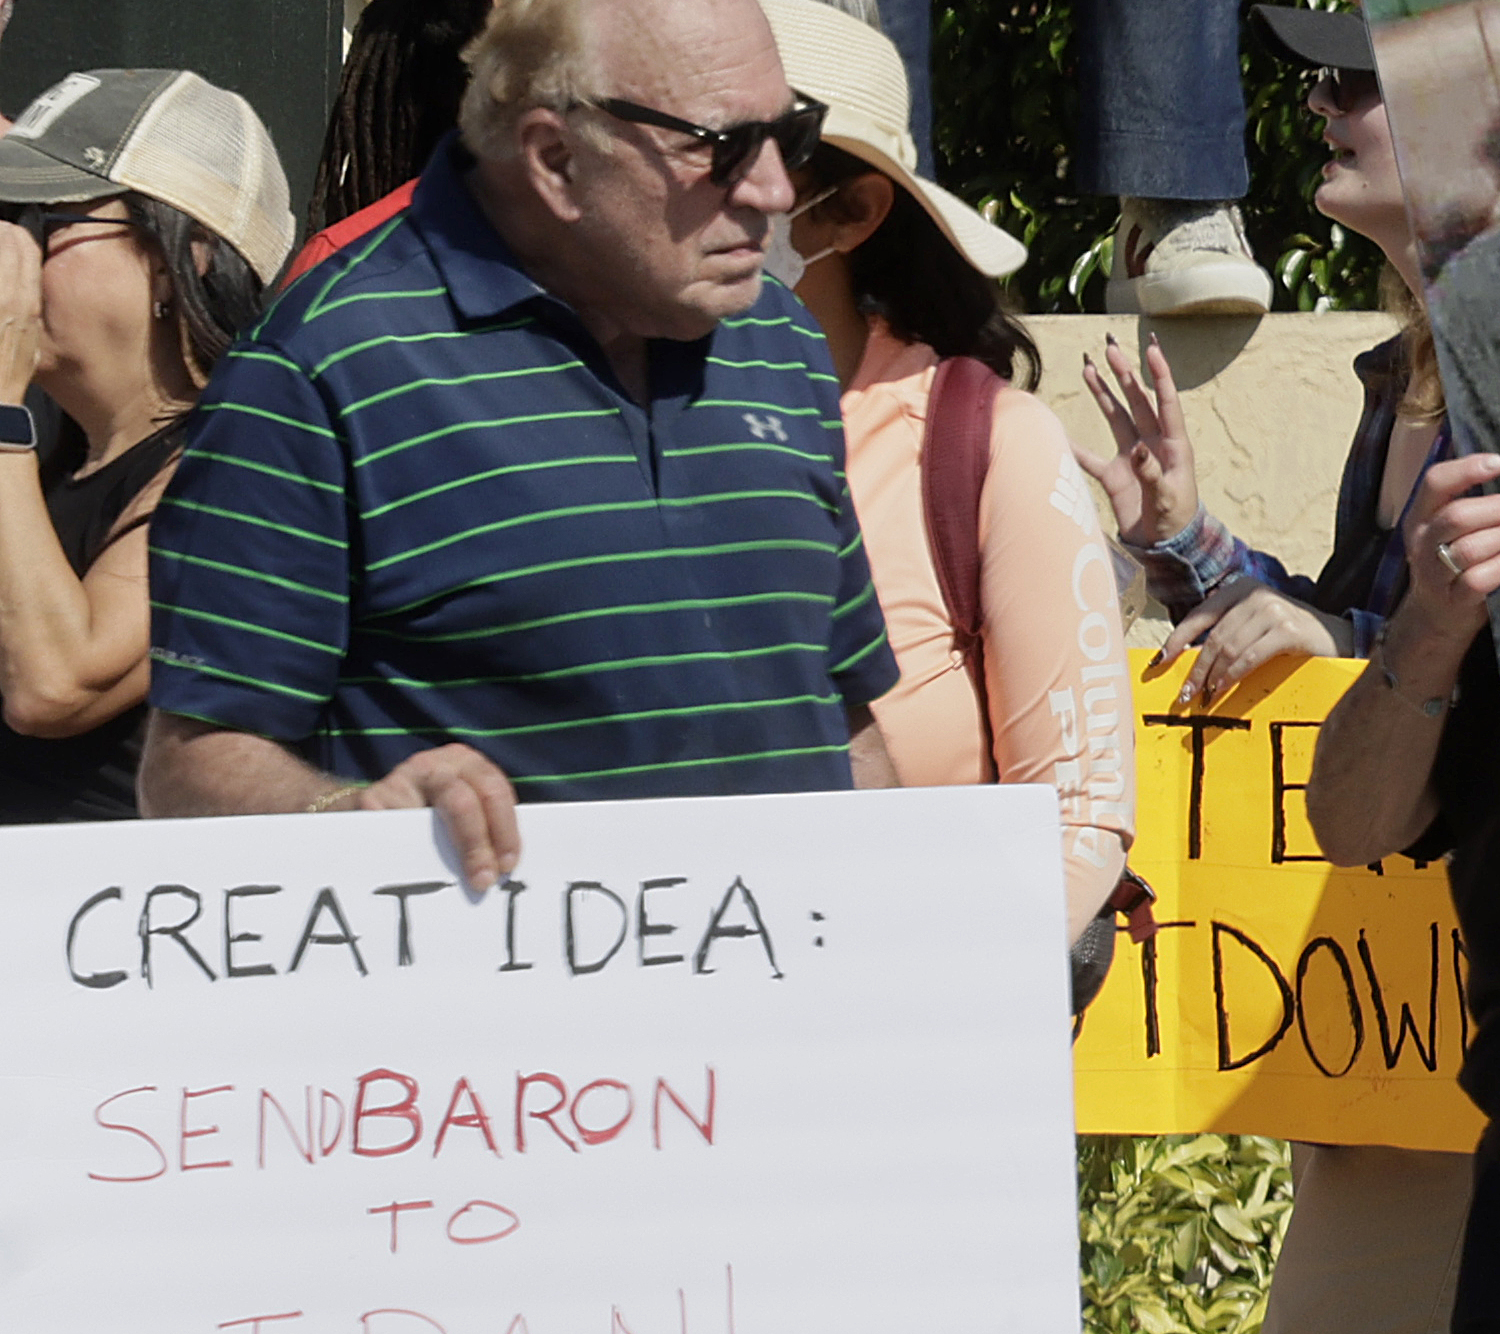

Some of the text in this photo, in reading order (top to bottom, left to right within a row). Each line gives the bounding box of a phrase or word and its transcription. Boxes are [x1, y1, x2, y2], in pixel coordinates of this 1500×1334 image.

[1071, 543, 1134, 869] Columba
[497, 875, 826, 980] IDEA:
[368, 1199, 521, 1253] TO
